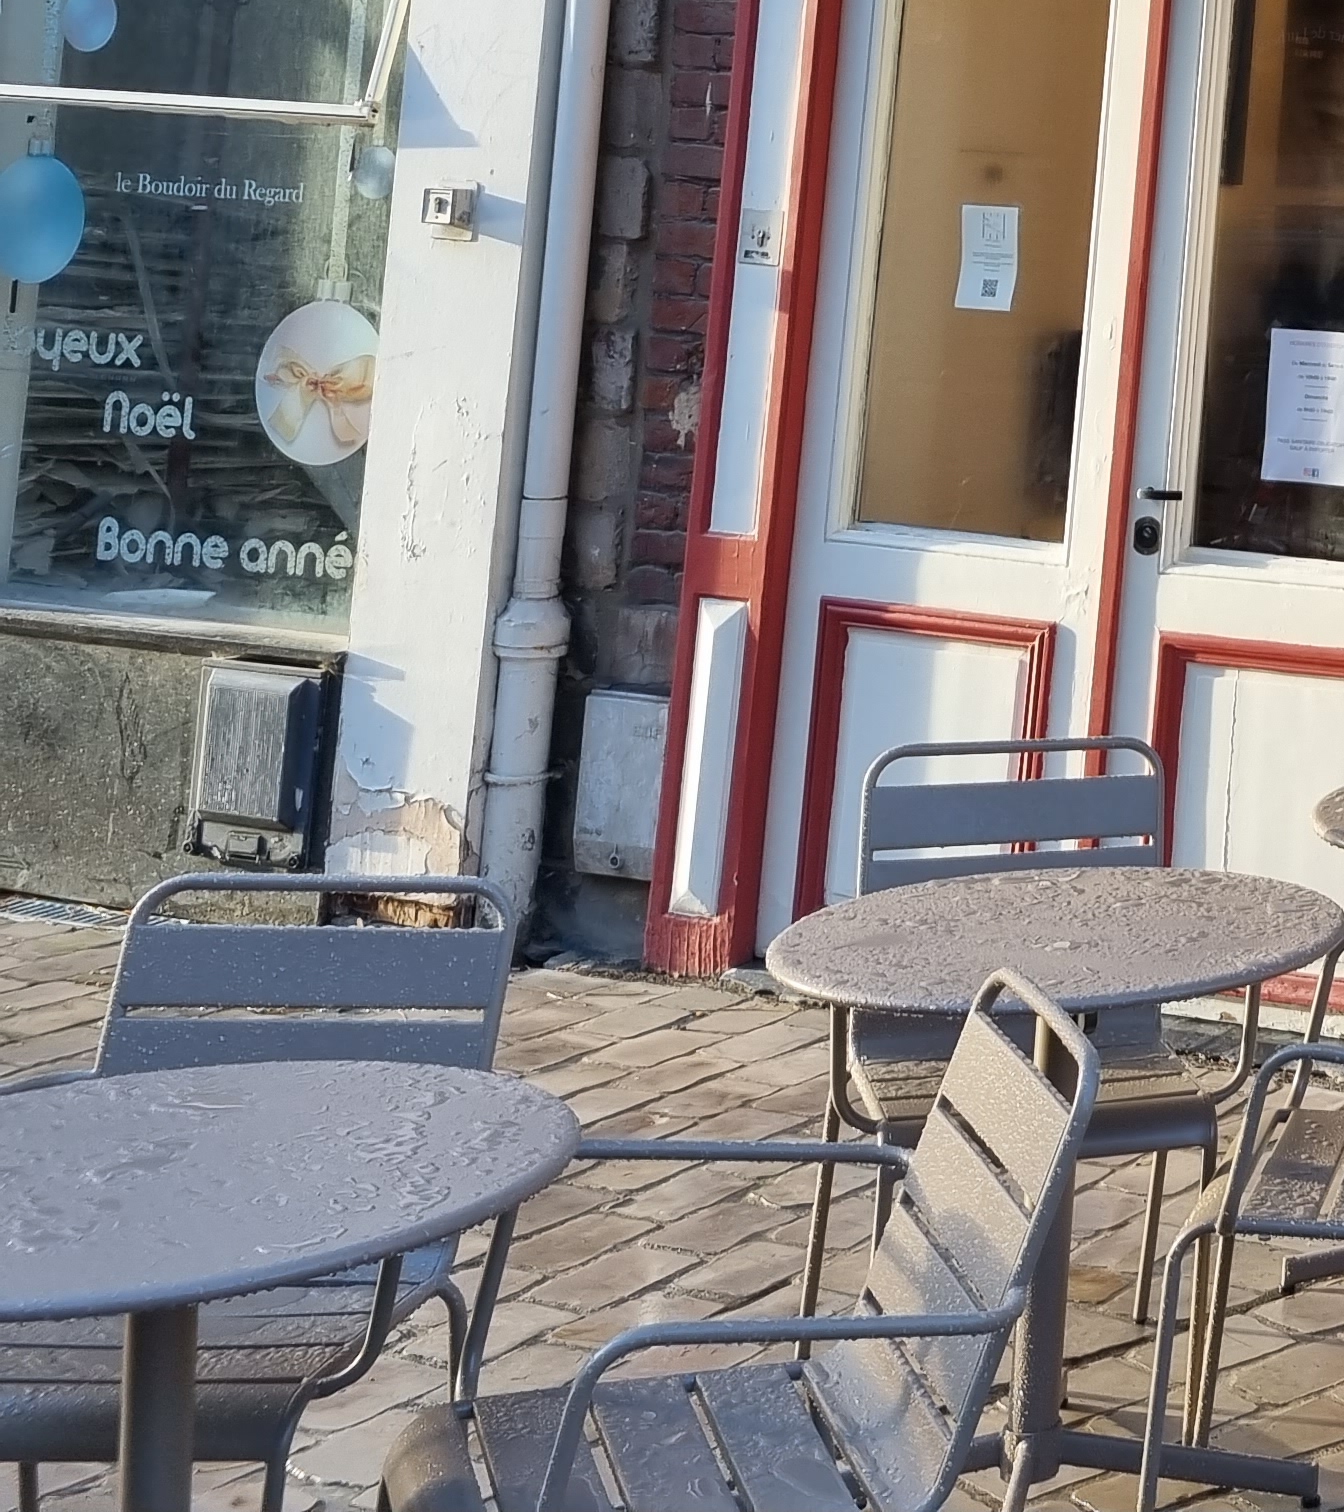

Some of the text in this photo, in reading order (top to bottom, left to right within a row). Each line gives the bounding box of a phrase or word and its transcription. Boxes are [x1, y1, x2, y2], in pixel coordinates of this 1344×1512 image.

[116, 172, 304, 206] le Boudoir du Regard
[32, 326, 143, 371] yeux
[103, 390, 196, 439] Noël
[96, 516, 356, 580] Bonne anné
